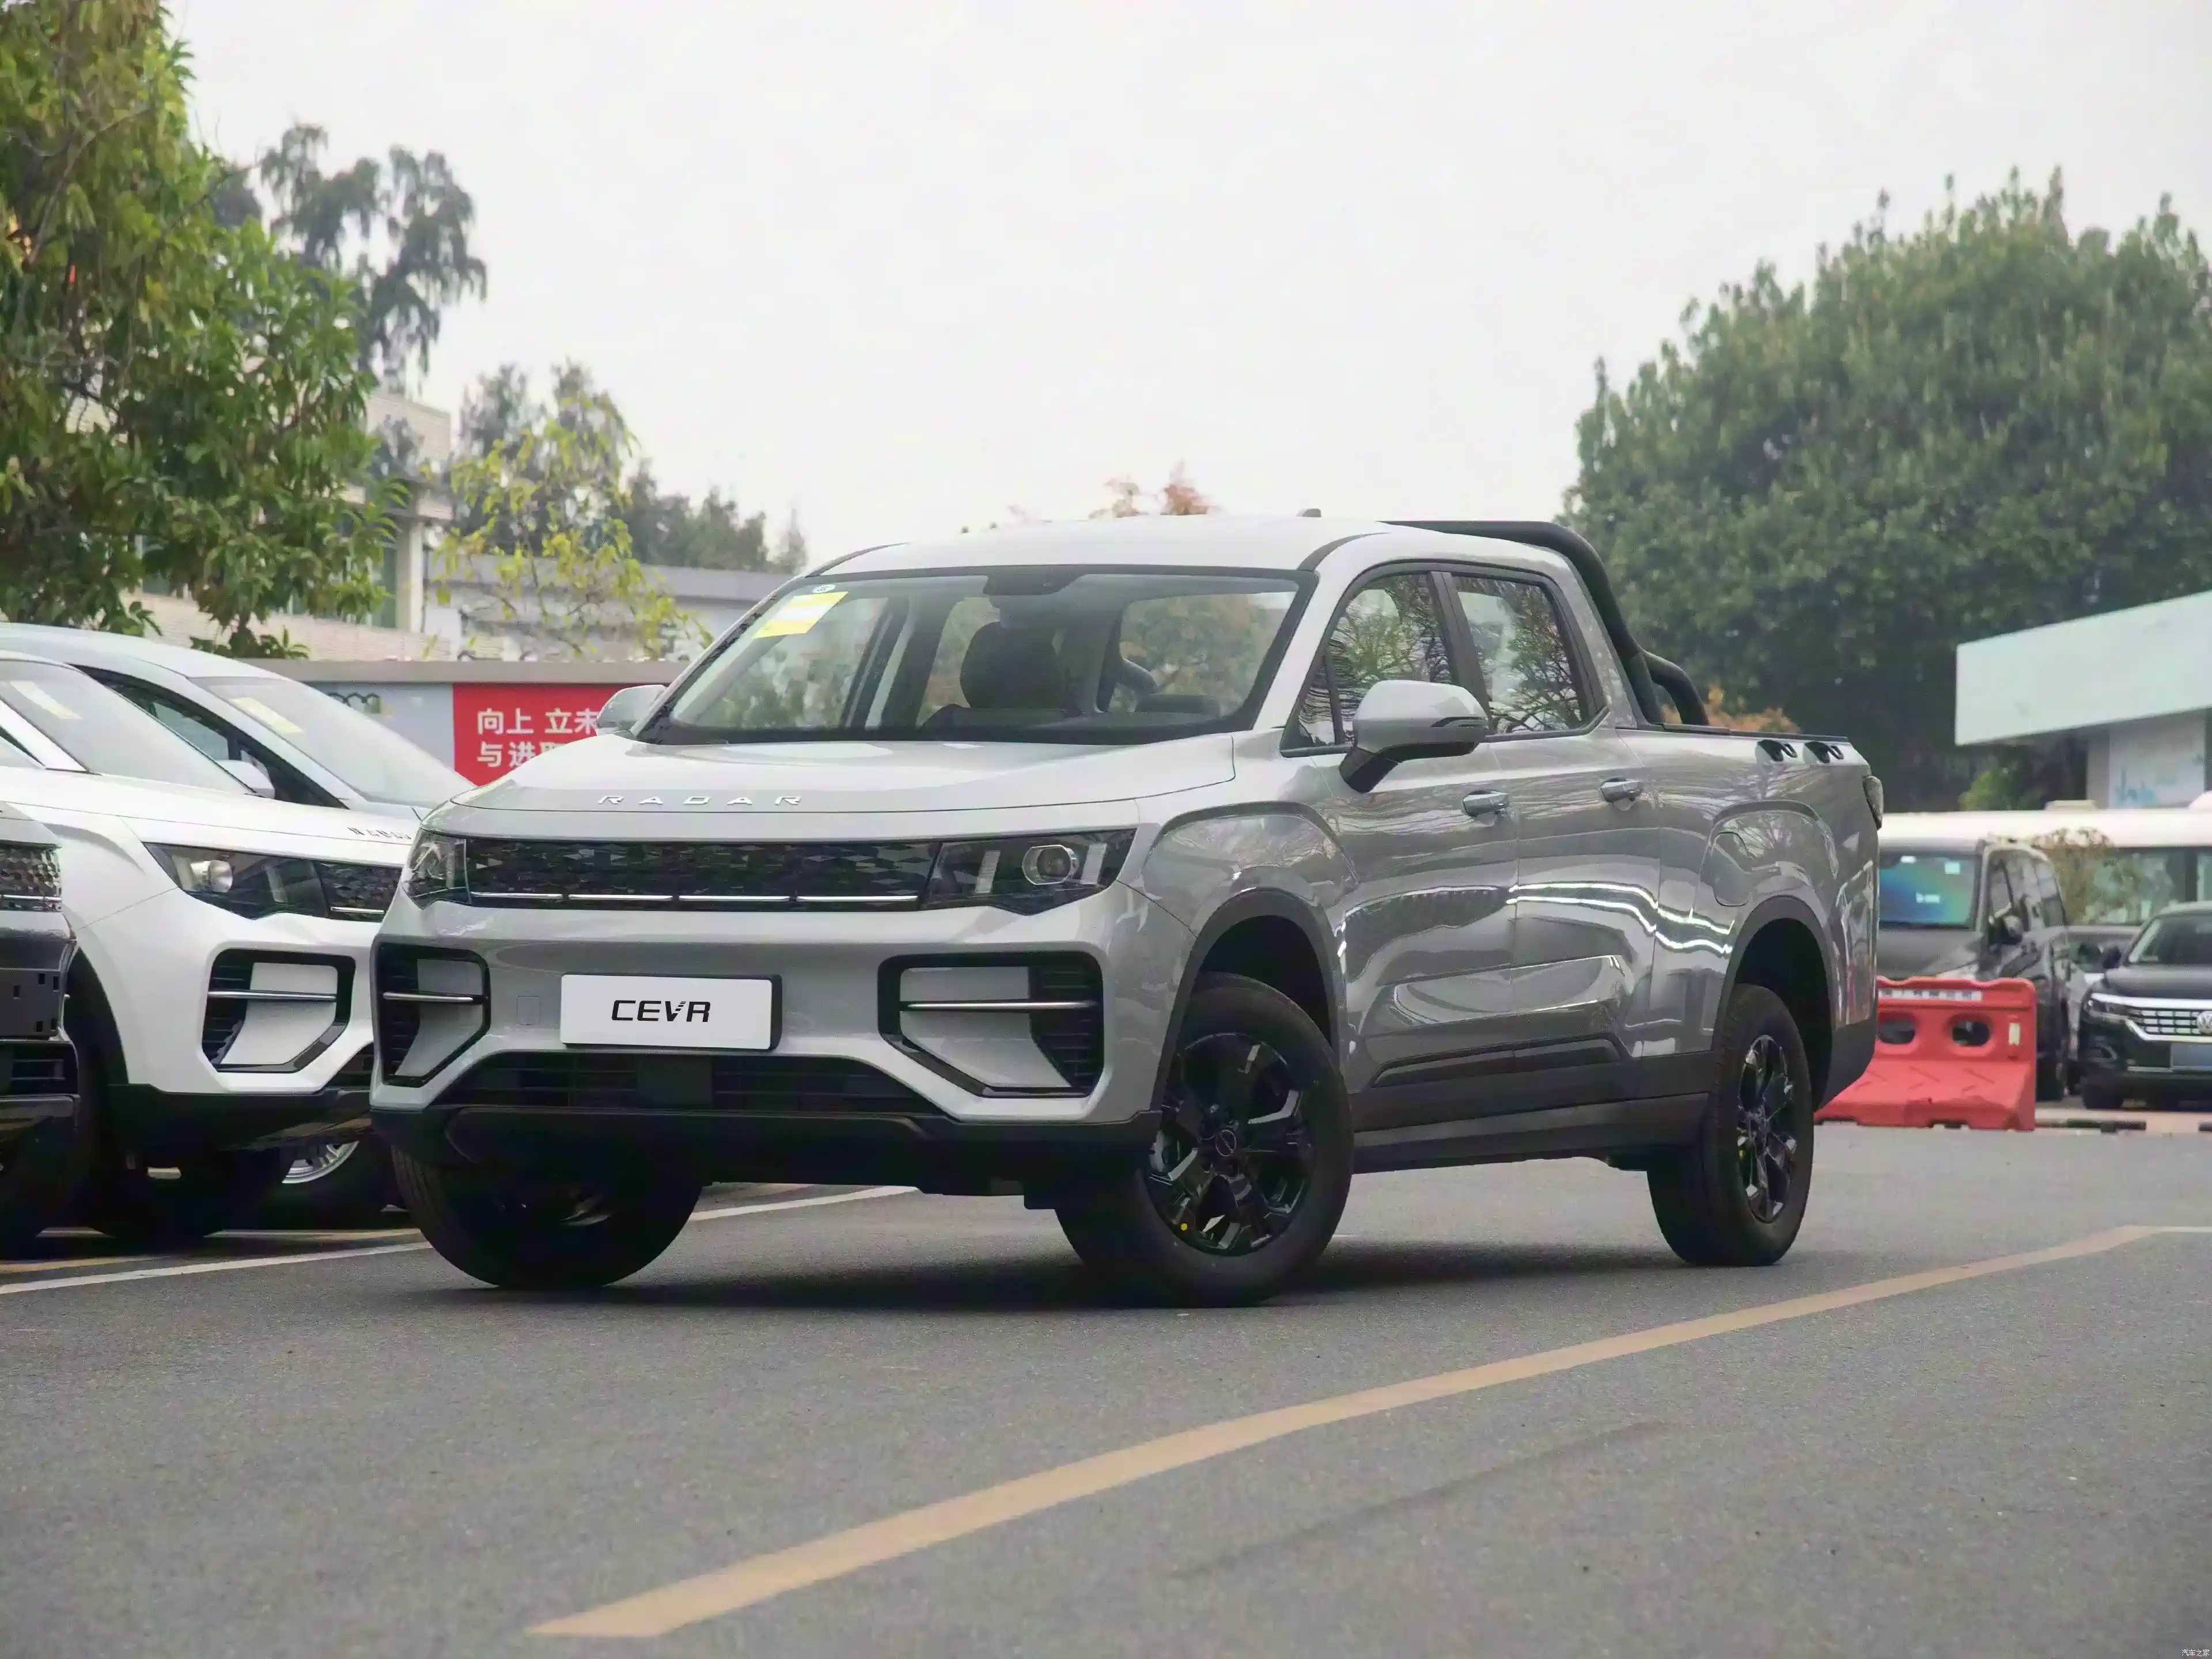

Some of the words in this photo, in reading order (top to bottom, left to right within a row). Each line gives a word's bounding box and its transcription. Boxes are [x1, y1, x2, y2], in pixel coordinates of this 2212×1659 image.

[477, 707, 534, 735] 向上
[597, 795, 802, 805] RADAR
[611, 999, 711, 1022] CEVR
